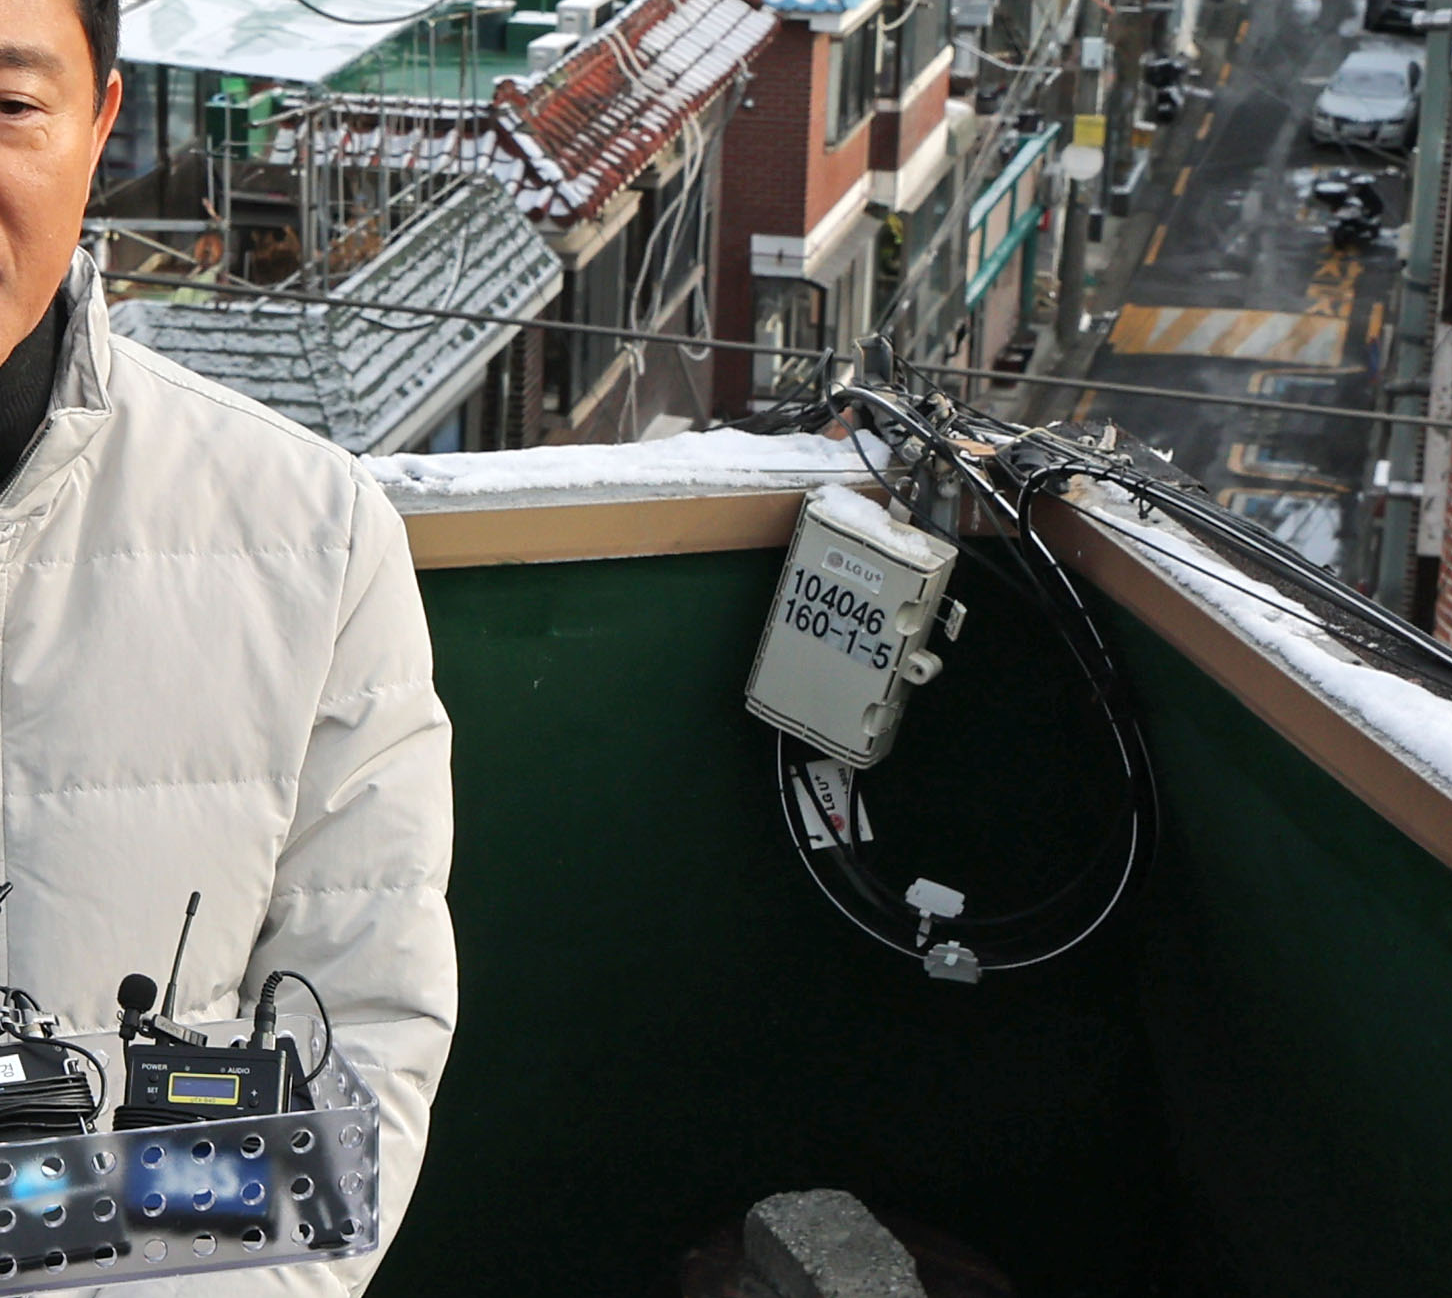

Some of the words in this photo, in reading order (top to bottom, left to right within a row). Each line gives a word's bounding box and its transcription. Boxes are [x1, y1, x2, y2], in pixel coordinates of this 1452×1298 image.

[844, 561, 862, 576] LG
[864, 569, 882, 582] U+
[795, 569, 885, 635] 104046
[785, 599, 894, 670] 160-1-5
[822, 793, 835, 811] LG
[141, 1063, 168, 1071] POWER
[147, 1086, 159, 1094] SET
